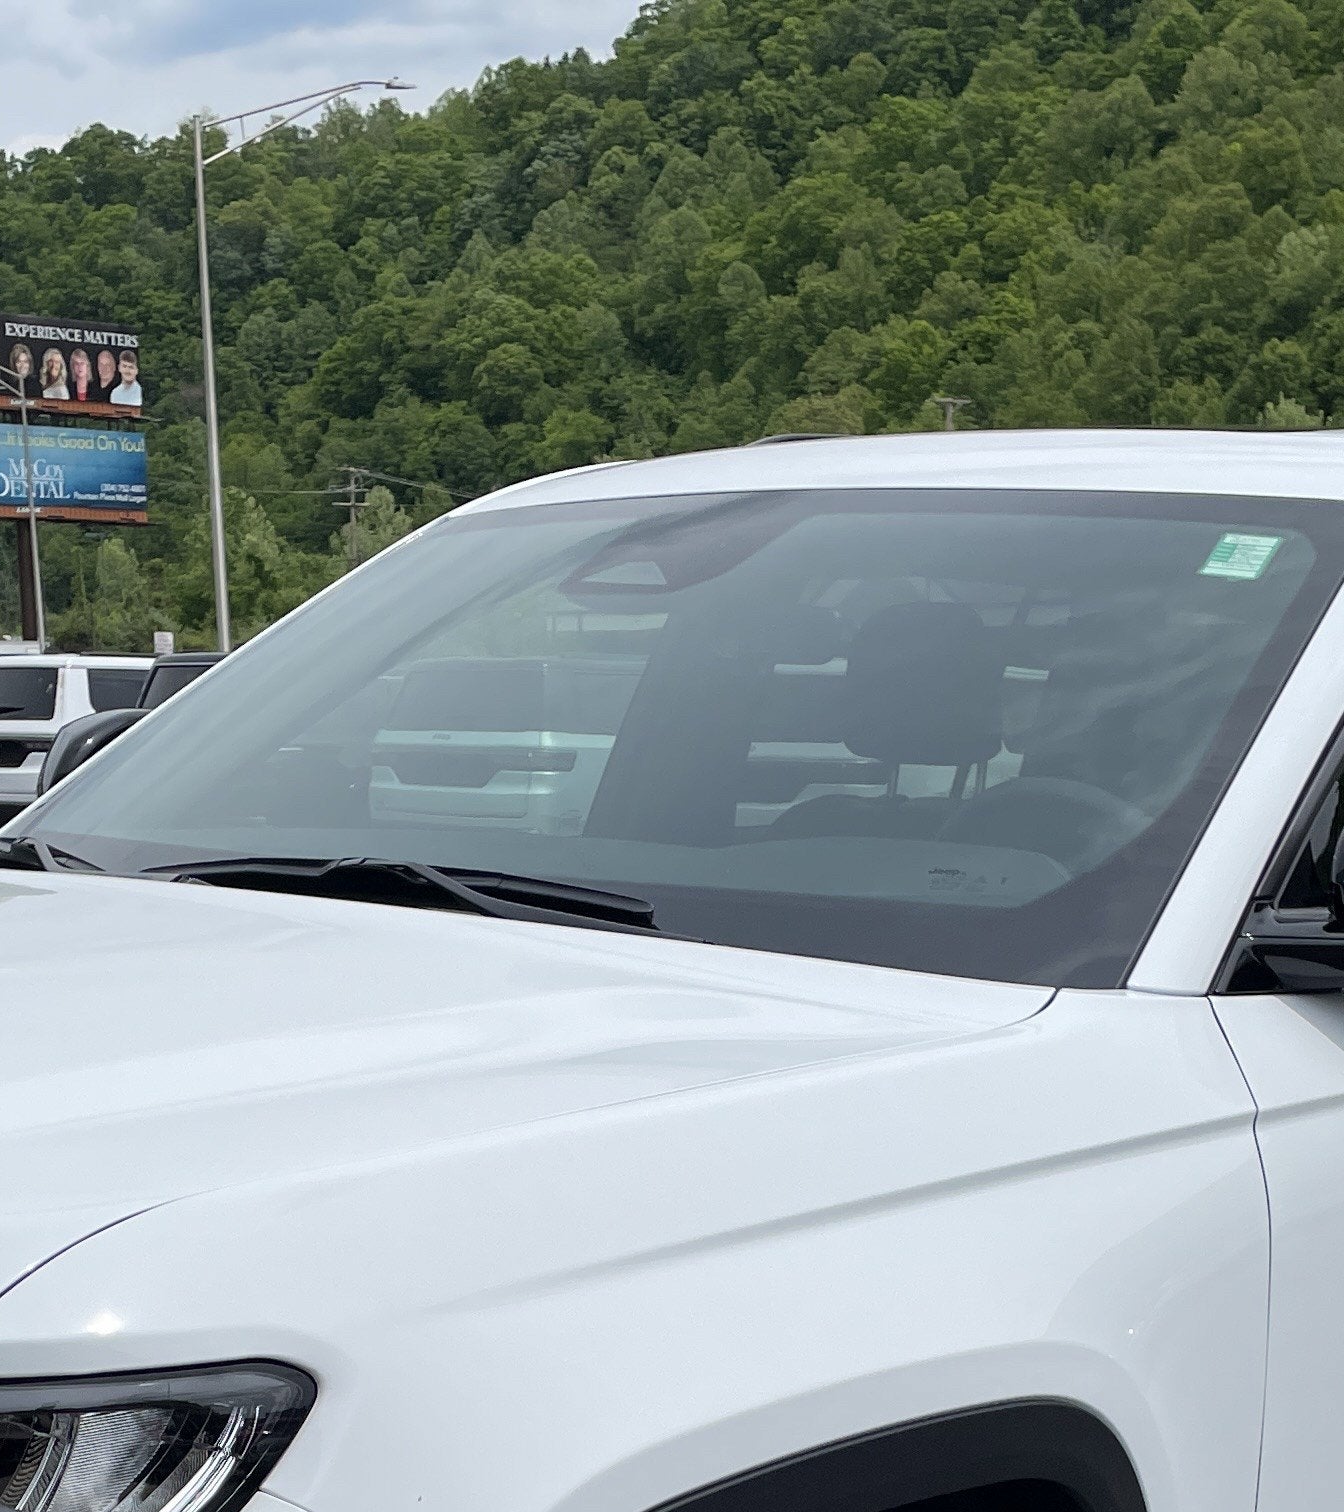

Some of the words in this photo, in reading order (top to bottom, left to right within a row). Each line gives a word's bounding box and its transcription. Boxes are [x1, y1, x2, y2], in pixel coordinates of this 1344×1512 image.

[5, 322, 82, 343] EXPERIENCE
[83, 329, 140, 348] MATTERS
[57, 432, 94, 450] Good
[97, 434, 117, 451] On
